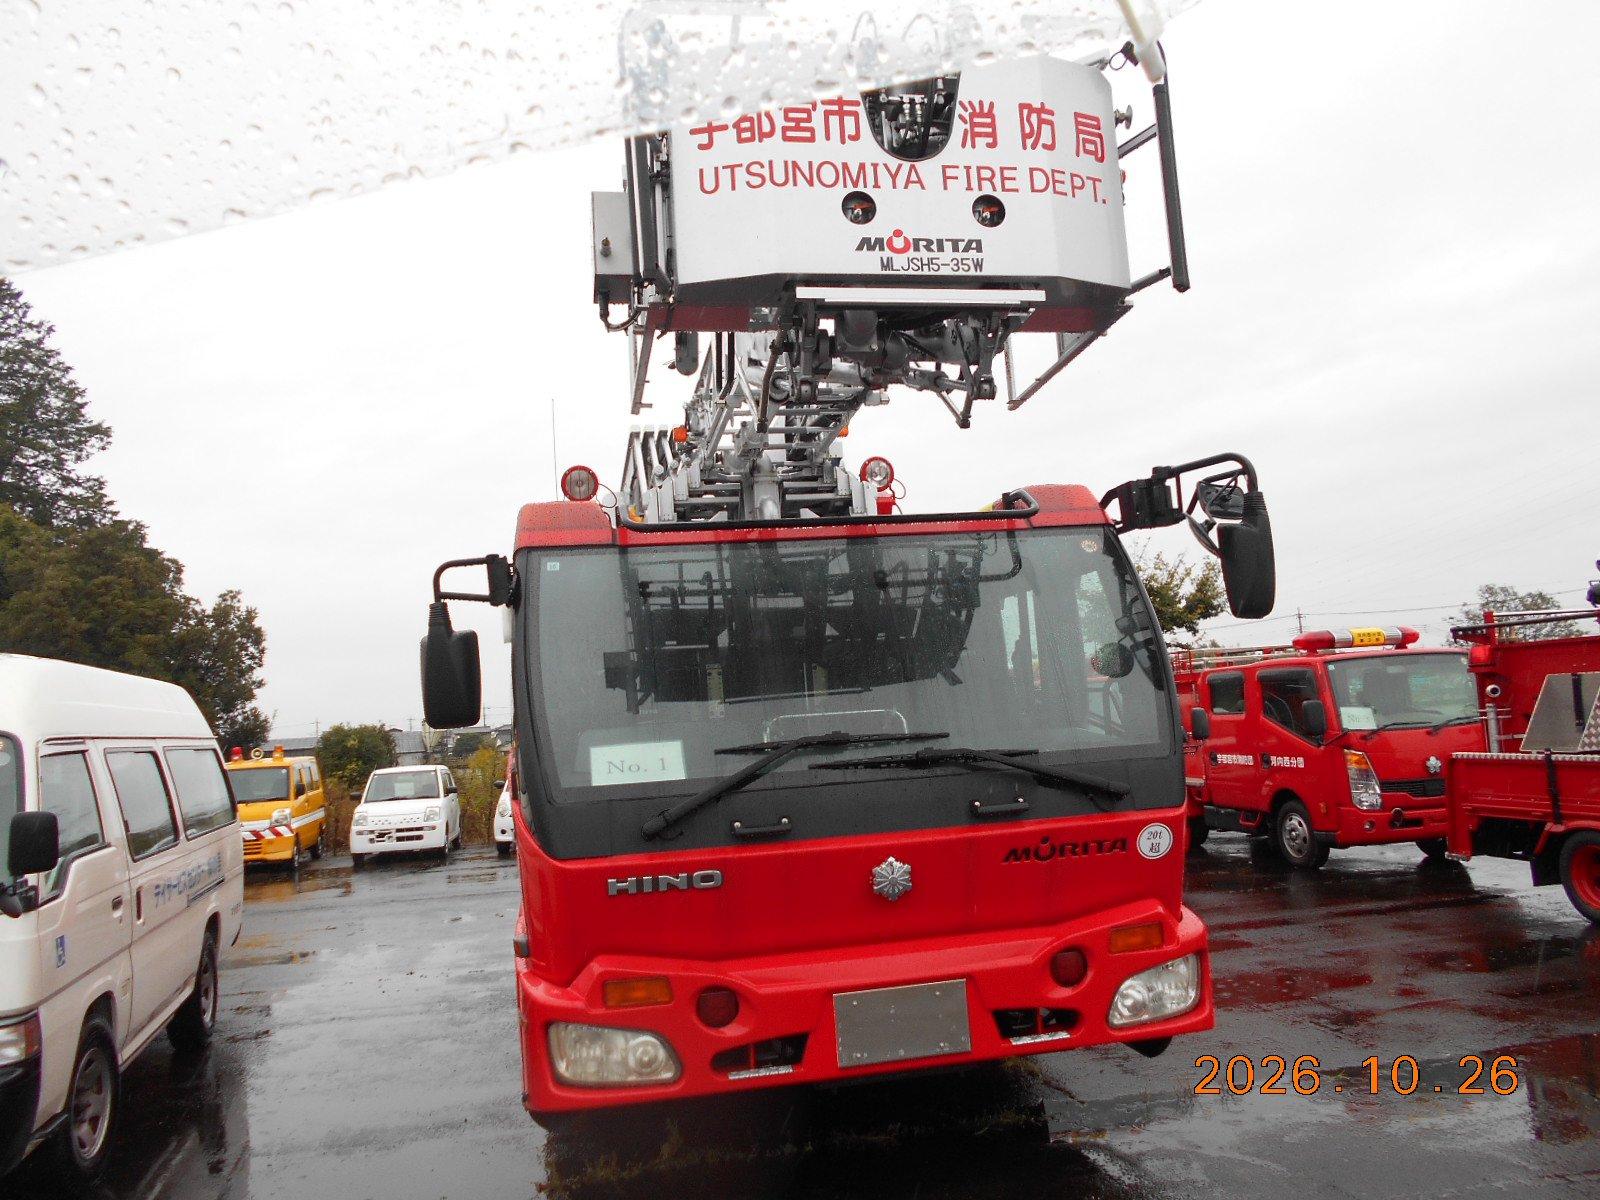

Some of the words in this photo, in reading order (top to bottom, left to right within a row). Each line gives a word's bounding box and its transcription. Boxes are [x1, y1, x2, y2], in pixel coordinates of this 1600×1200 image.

[958, 99, 1106, 164] 消防局
[698, 159, 927, 195] UTSUNOMIYA
[941, 163, 1020, 193] FIRE
[1029, 166, 1108, 205] DEPT.
[855, 228, 984, 254] MORITA
[879, 256, 984, 273] MLJSH5-35W
[607, 759, 648, 775] No.
[657, 757, 669, 772] 1
[1002, 835, 1130, 864] MORITA
[607, 869, 723, 896] HINO
